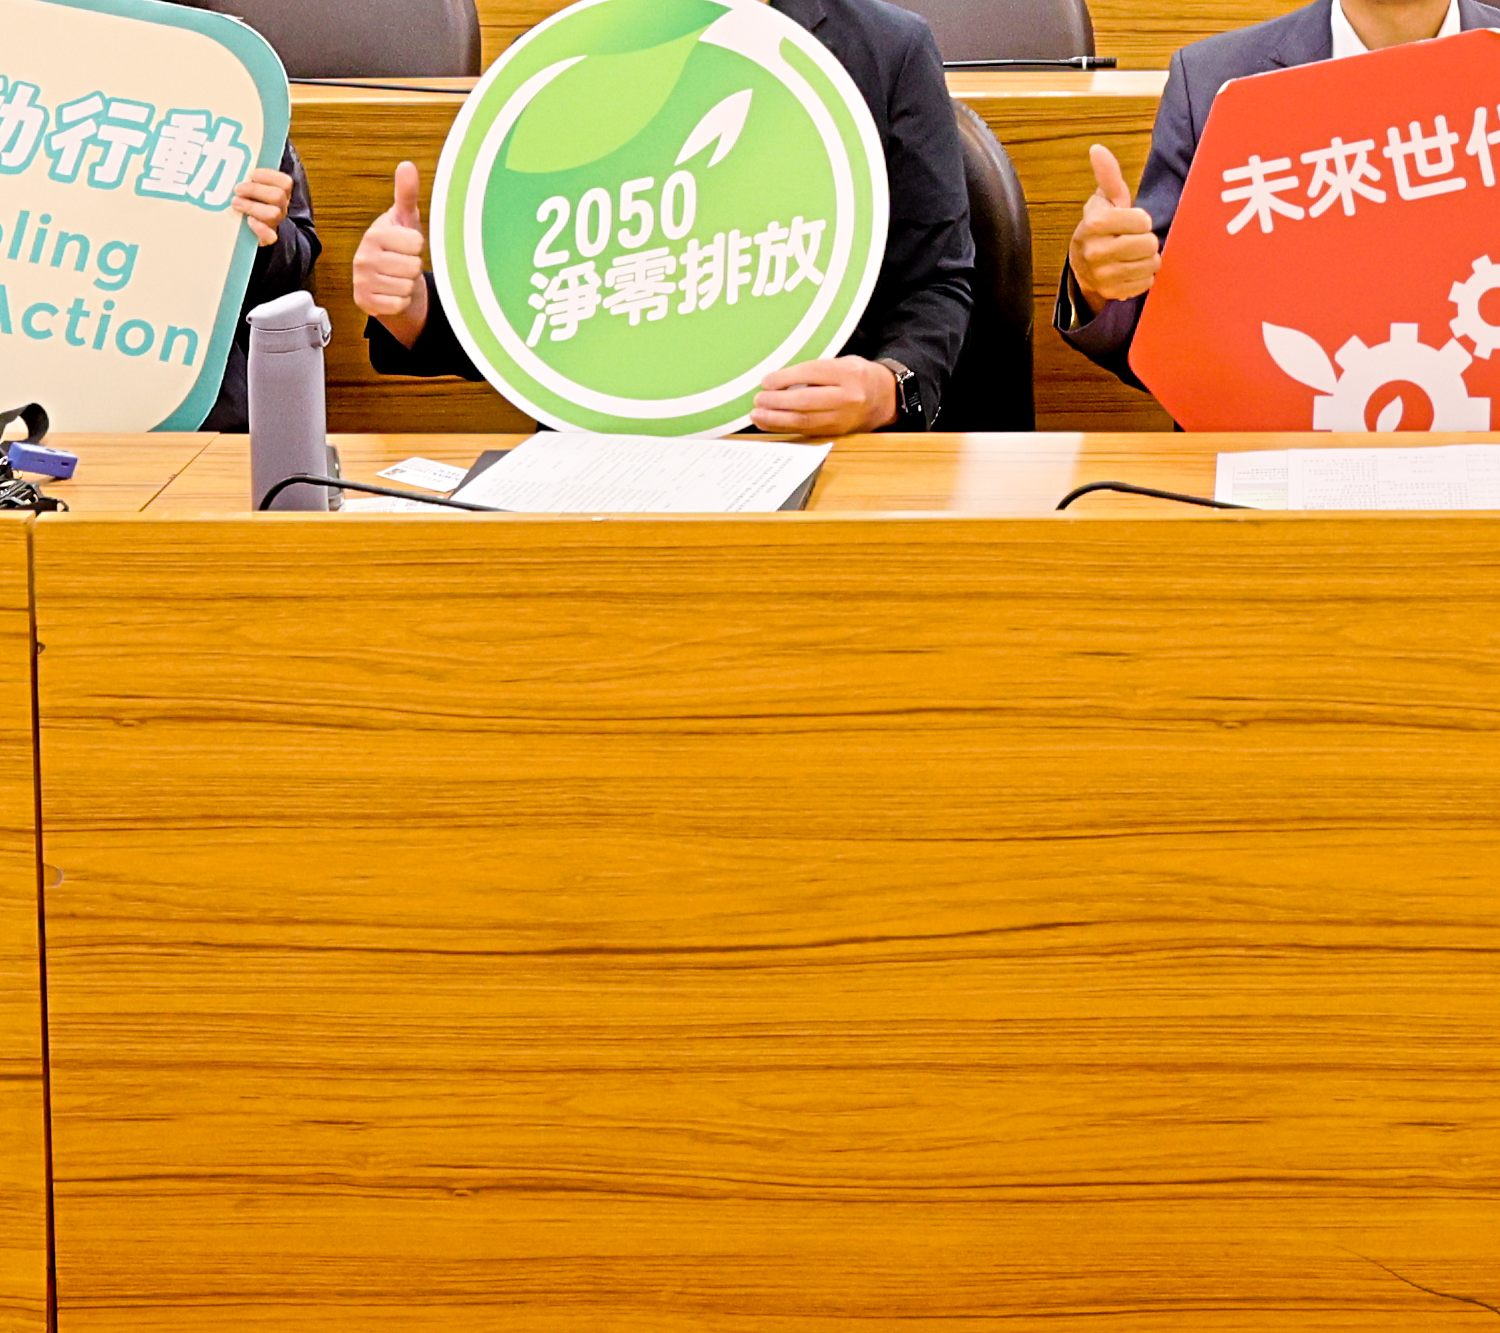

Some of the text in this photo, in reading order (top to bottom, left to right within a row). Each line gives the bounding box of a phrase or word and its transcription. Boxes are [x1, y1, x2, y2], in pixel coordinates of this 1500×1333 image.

[534, 170, 699, 265] 2050
[526, 211, 826, 350] 淨零排放
